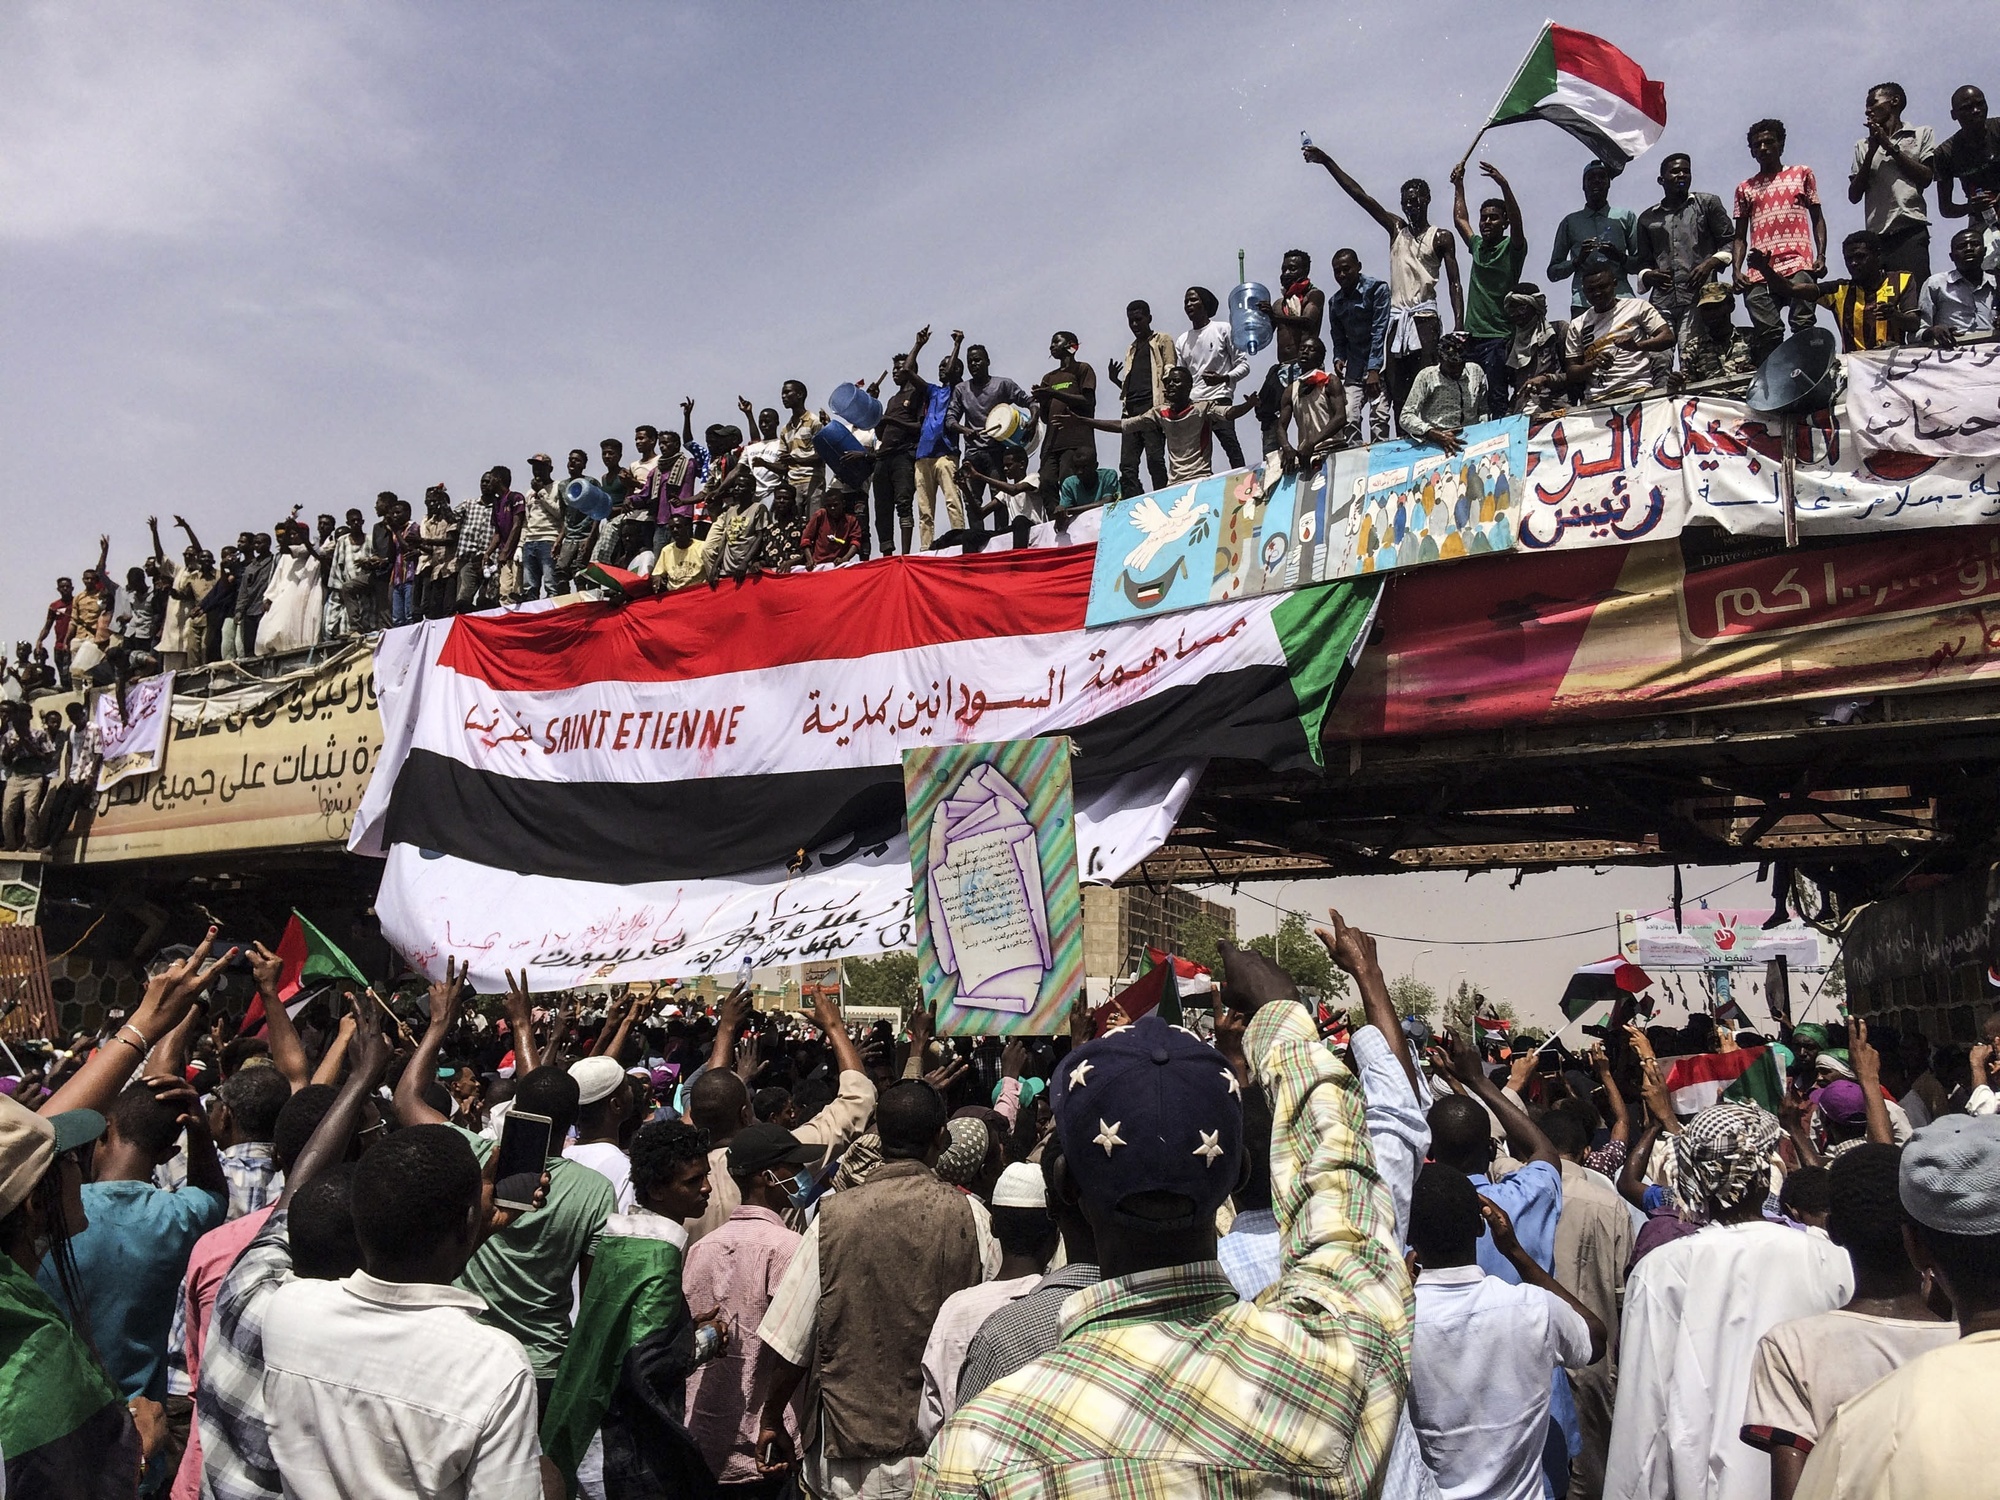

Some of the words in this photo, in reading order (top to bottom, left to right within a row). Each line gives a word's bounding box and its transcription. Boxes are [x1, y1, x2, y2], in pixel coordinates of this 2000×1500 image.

[1519, 476, 1665, 548] رئيس
[1853, 485, 1944, 519] سلام
[1715, 568, 1811, 632] كم
[1080, 616, 1247, 692] مساهمة
[802, 684, 895, 747] بمدينة
[152, 769, 215, 810] جميع
[220, 753, 266, 802] على
[273, 735, 347, 792] بثبات
